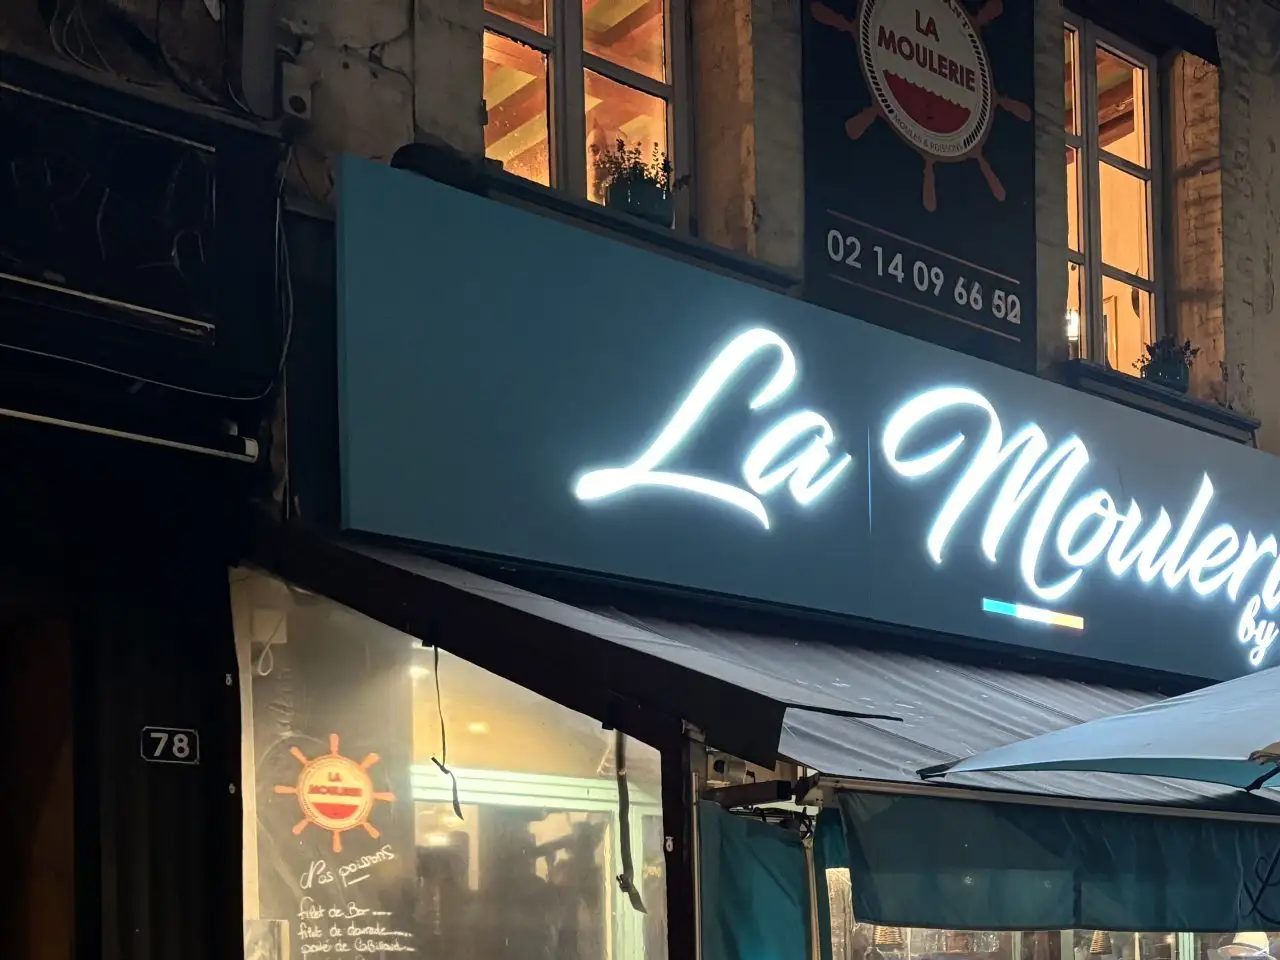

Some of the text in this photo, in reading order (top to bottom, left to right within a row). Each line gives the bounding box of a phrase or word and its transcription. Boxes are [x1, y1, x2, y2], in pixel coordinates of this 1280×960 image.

[877, 25, 976, 93] MOULERIE
[915, 9, 940, 42] LA
[827, 229, 1021, 325] 02 14 09 66 52
[574, 327, 852, 530] La
[1238, 594, 1280, 667] by
[150, 732, 190, 758] 78
[300, 844, 396, 889] Nos poissons
